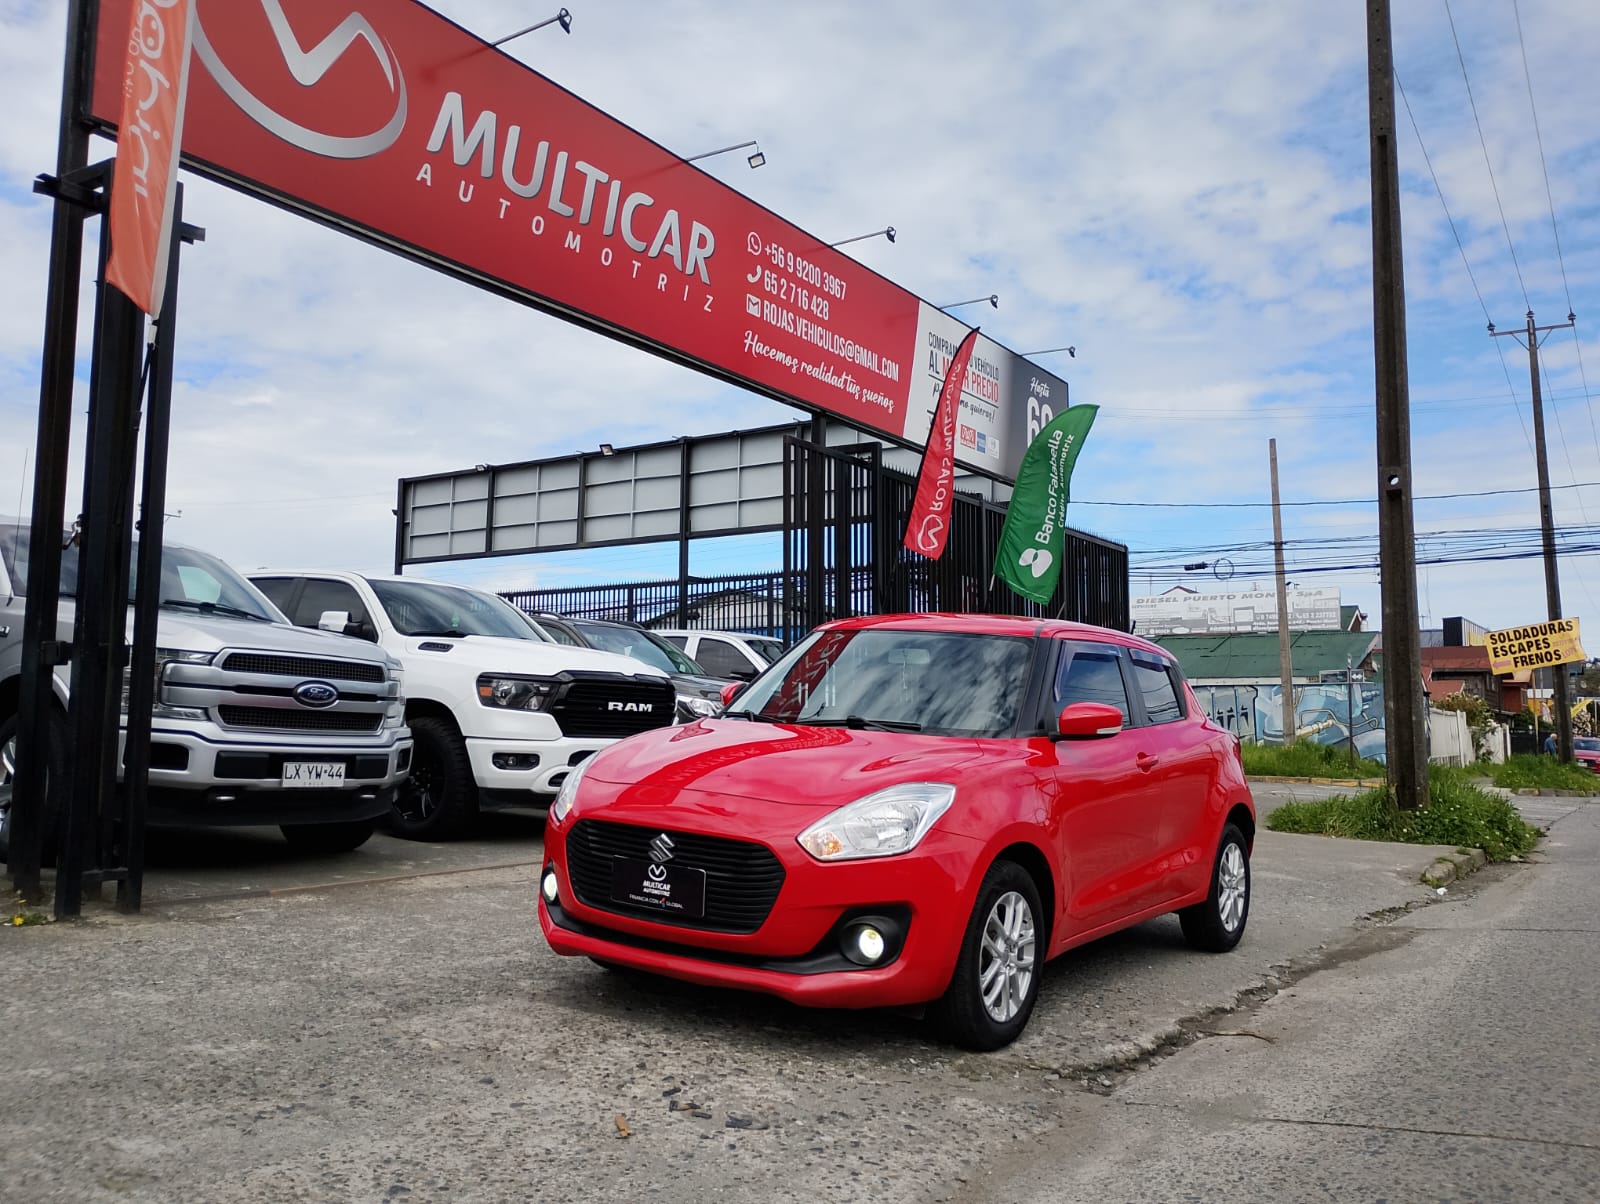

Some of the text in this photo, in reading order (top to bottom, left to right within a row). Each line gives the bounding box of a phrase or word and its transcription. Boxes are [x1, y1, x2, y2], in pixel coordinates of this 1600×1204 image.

[426, 92, 714, 285] MULTICAR
[416, 163, 713, 312] AUTOMOTRIZ
[764, 270, 778, 295] 65
[811, 295, 829, 320] 428
[765, 243, 847, 300] +56 9 9200 3967
[763, 299, 899, 382] ROJAS.VEHICULOS@GMAIL.COM
[744, 330, 896, 413] Hacemos realidad tus sueños
[929, 350, 940, 375] AL
[972, 371, 999, 403] PRECIO
[1035, 430, 1063, 544] Banco Falabella
[1060, 434, 1075, 489] Automotriz
[1136, 596, 1179, 604] DIESEL
[1183, 594, 1236, 602] PUERTO
[1490, 620, 1574, 646] SOLDADURAS
[1492, 637, 1551, 659] ESCAPES
[1513, 649, 1561, 668] FRENOS
[607, 702, 652, 713] RAM
[643, 880, 671, 891] MULTICAR
